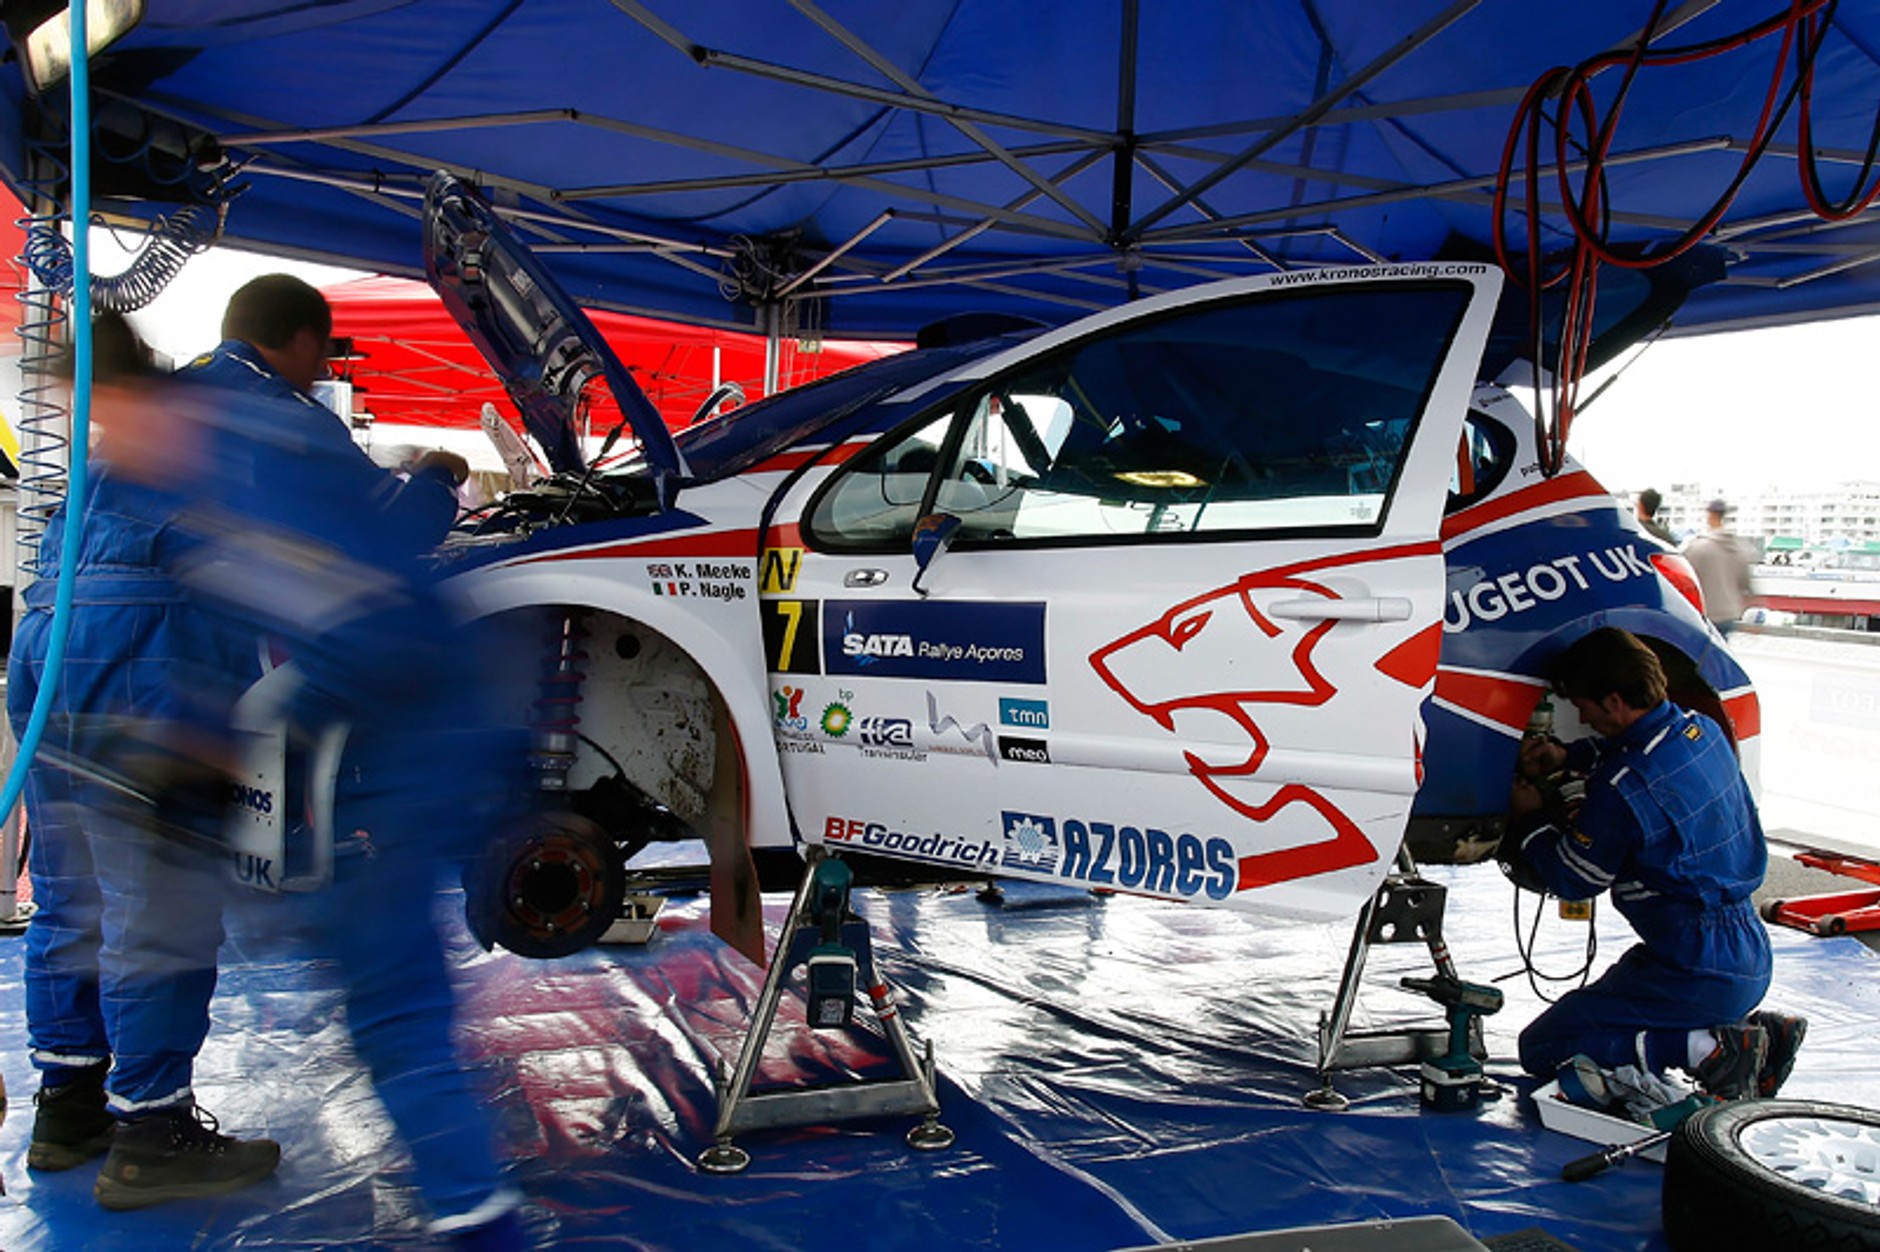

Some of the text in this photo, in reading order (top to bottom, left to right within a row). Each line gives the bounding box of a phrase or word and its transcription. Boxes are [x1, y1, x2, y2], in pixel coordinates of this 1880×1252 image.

[1270, 263, 1487, 286] www.kronosracing.com
[674, 563, 751, 579] K. Meeke
[1588, 544, 1654, 582] UK
[679, 582, 746, 602] P. Nagle
[777, 601, 802, 672] 7
[843, 634, 1024, 664] SATA Rallye Açores
[838, 688, 855, 703] bp
[1008, 708, 1047, 726] tmn
[1008, 746, 1047, 762] meo
[825, 816, 998, 866] BFGoodrich
[235, 852, 275, 888] UK
